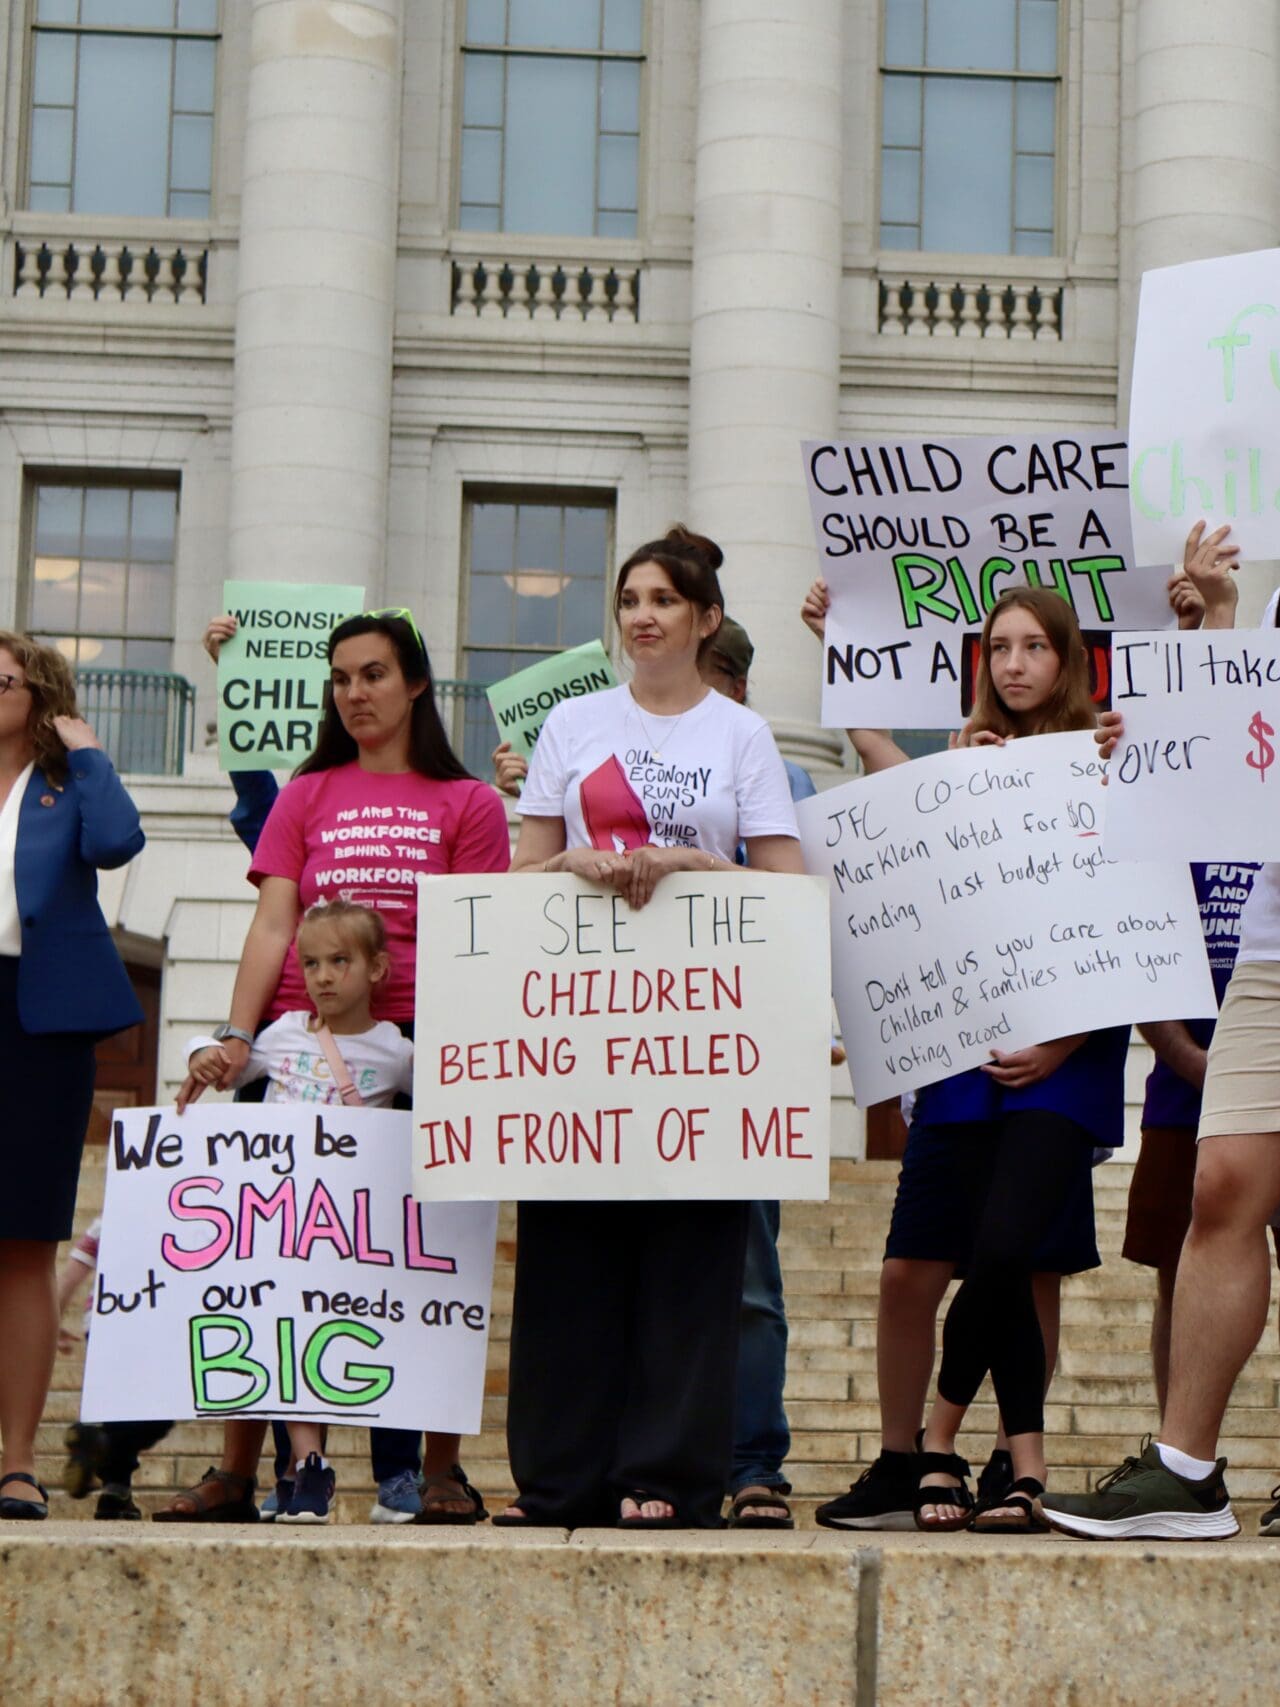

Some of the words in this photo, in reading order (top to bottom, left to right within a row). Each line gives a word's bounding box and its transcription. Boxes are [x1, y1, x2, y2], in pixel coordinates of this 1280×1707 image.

[810, 444, 962, 496] CHILD
[987, 440, 1129, 494] CARE
[822, 512, 970, 556] SHOULD
[990, 512, 1057, 552] BE
[1079, 509, 1111, 549] A
[892, 553, 1127, 628] RIGHT
[228, 609, 345, 630] WISONSI
[246, 639, 329, 659] NEEDS
[827, 641, 911, 685] NOT
[930, 641, 958, 683] A
[1116, 640, 1183, 699] I'll
[499, 668, 610, 727] WISONSIN
[625, 748, 664, 766] OUR
[629, 764, 712, 798] ECONOMY
[1118, 735, 1211, 784] over
[361, 806, 393, 819] ARE
[396, 805, 429, 822] THE
[642, 784, 696, 807] RUNS
[651, 802, 675, 820] ON
[1023, 813, 1058, 834] for
[1067, 800, 1097, 830] $0
[321, 825, 442, 844] WORKFORCE
[655, 822, 698, 840] CHILD
[826, 801, 888, 848] JFC
[334, 844, 392, 859] BEHIND
[394, 845, 428, 860] THE
[1205, 863, 1254, 885] FUT
[847, 902, 922, 939] funding
[939, 871, 985, 904] last
[1001, 851, 1063, 885] budget
[1208, 885, 1249, 901] AND
[454, 895, 490, 959] I
[541, 894, 636, 955] SEE
[675, 895, 768, 948] THE
[919, 958, 947, 992] tell
[956, 950, 979, 975] us
[995, 935, 1035, 977] you
[1117, 911, 1179, 936] about
[522, 965, 743, 1020] CHILDREN
[952, 986, 970, 1016] &
[979, 963, 1058, 1003] families
[1075, 947, 1122, 977] with
[1135, 950, 1183, 983] your
[439, 1035, 578, 1086] BEING
[606, 1033, 761, 1078] FAILED
[885, 1043, 953, 1076] voting
[958, 1012, 1012, 1049] record
[113, 1119, 184, 1171] We
[206, 1134, 295, 1176] may
[314, 1113, 358, 1158] be
[420, 1118, 474, 1171] IN
[496, 1107, 636, 1166] FRONT
[656, 1109, 709, 1162] OF
[741, 1107, 814, 1161] ME
[161, 1176, 458, 1273] SMALL
[96, 1270, 166, 1317] but
[201, 1278, 277, 1311] our
[301, 1286, 405, 1325] needs
[421, 1299, 486, 1332] are
[189, 1315, 394, 1412] BIG
